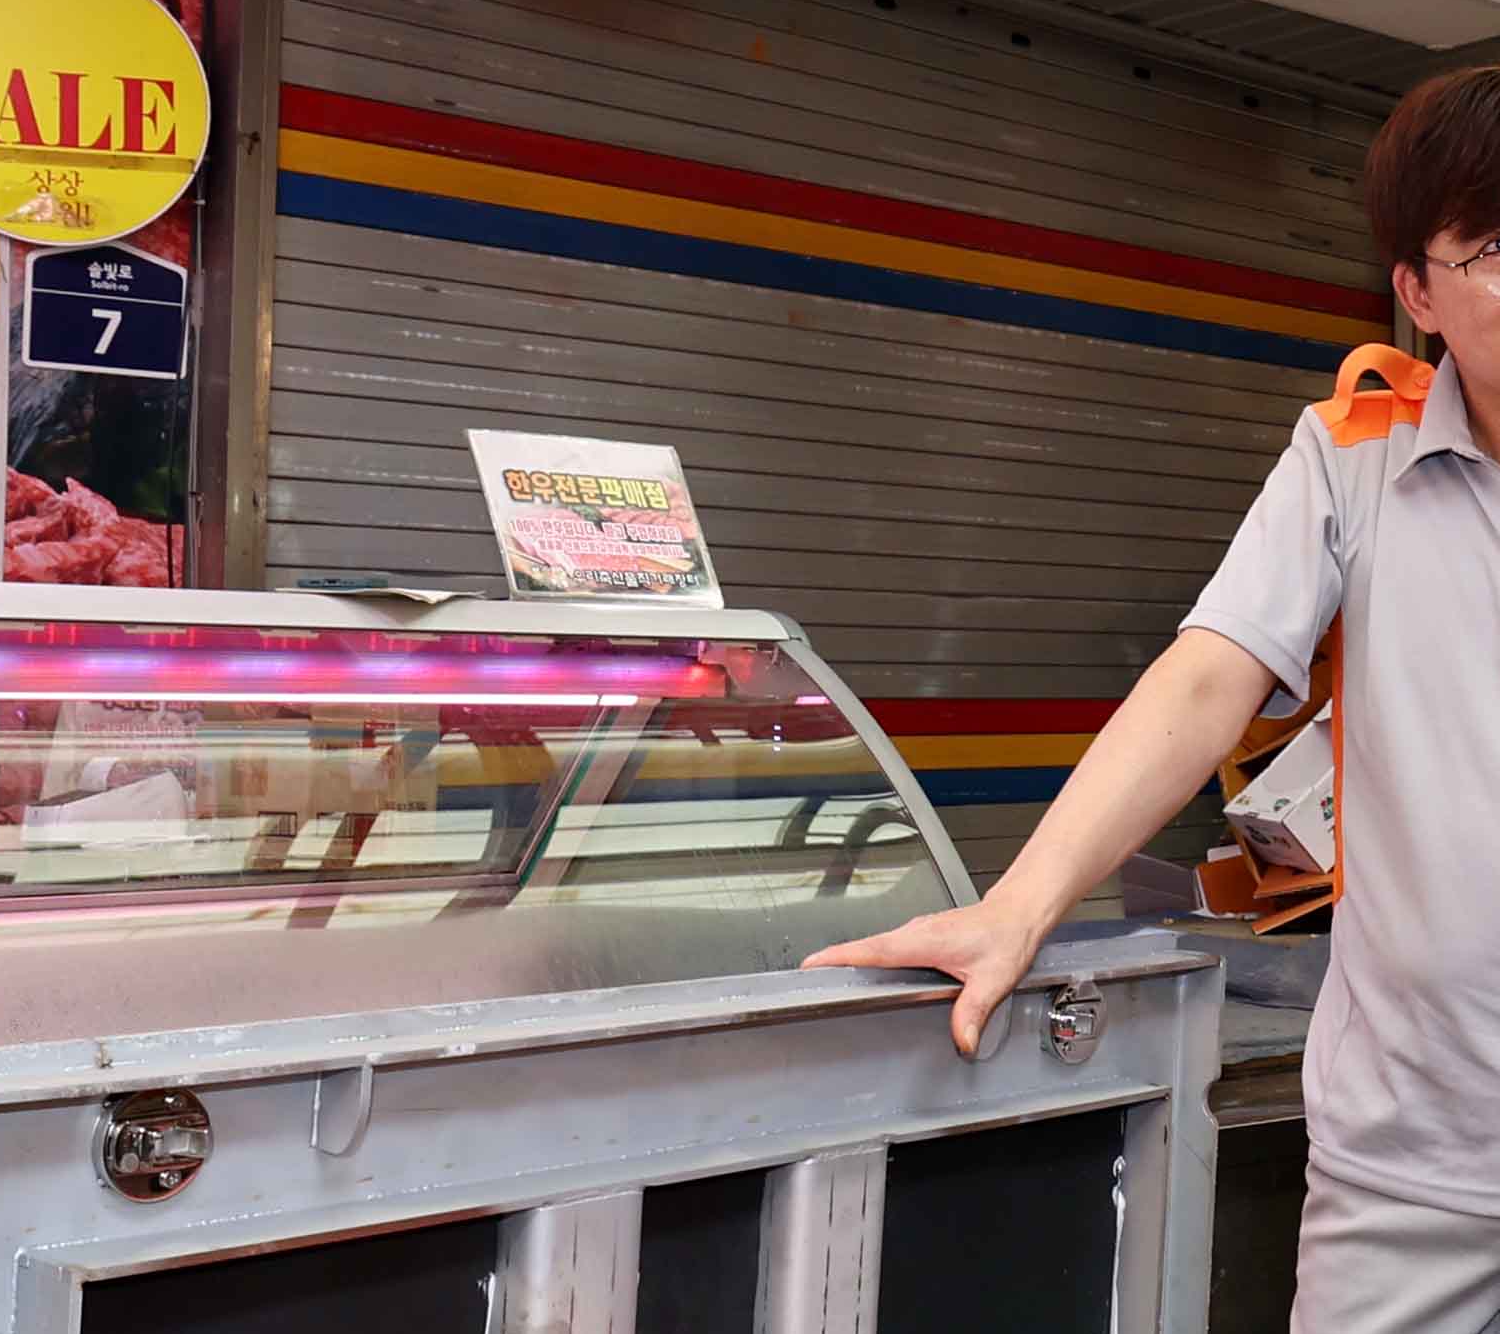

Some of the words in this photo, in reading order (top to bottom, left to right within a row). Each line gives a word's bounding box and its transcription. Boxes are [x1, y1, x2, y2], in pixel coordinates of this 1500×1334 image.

[88, 260, 133, 281] 솔빛로
[91, 308, 123, 355] 7
[503, 469, 670, 510] 한우전문판매점
